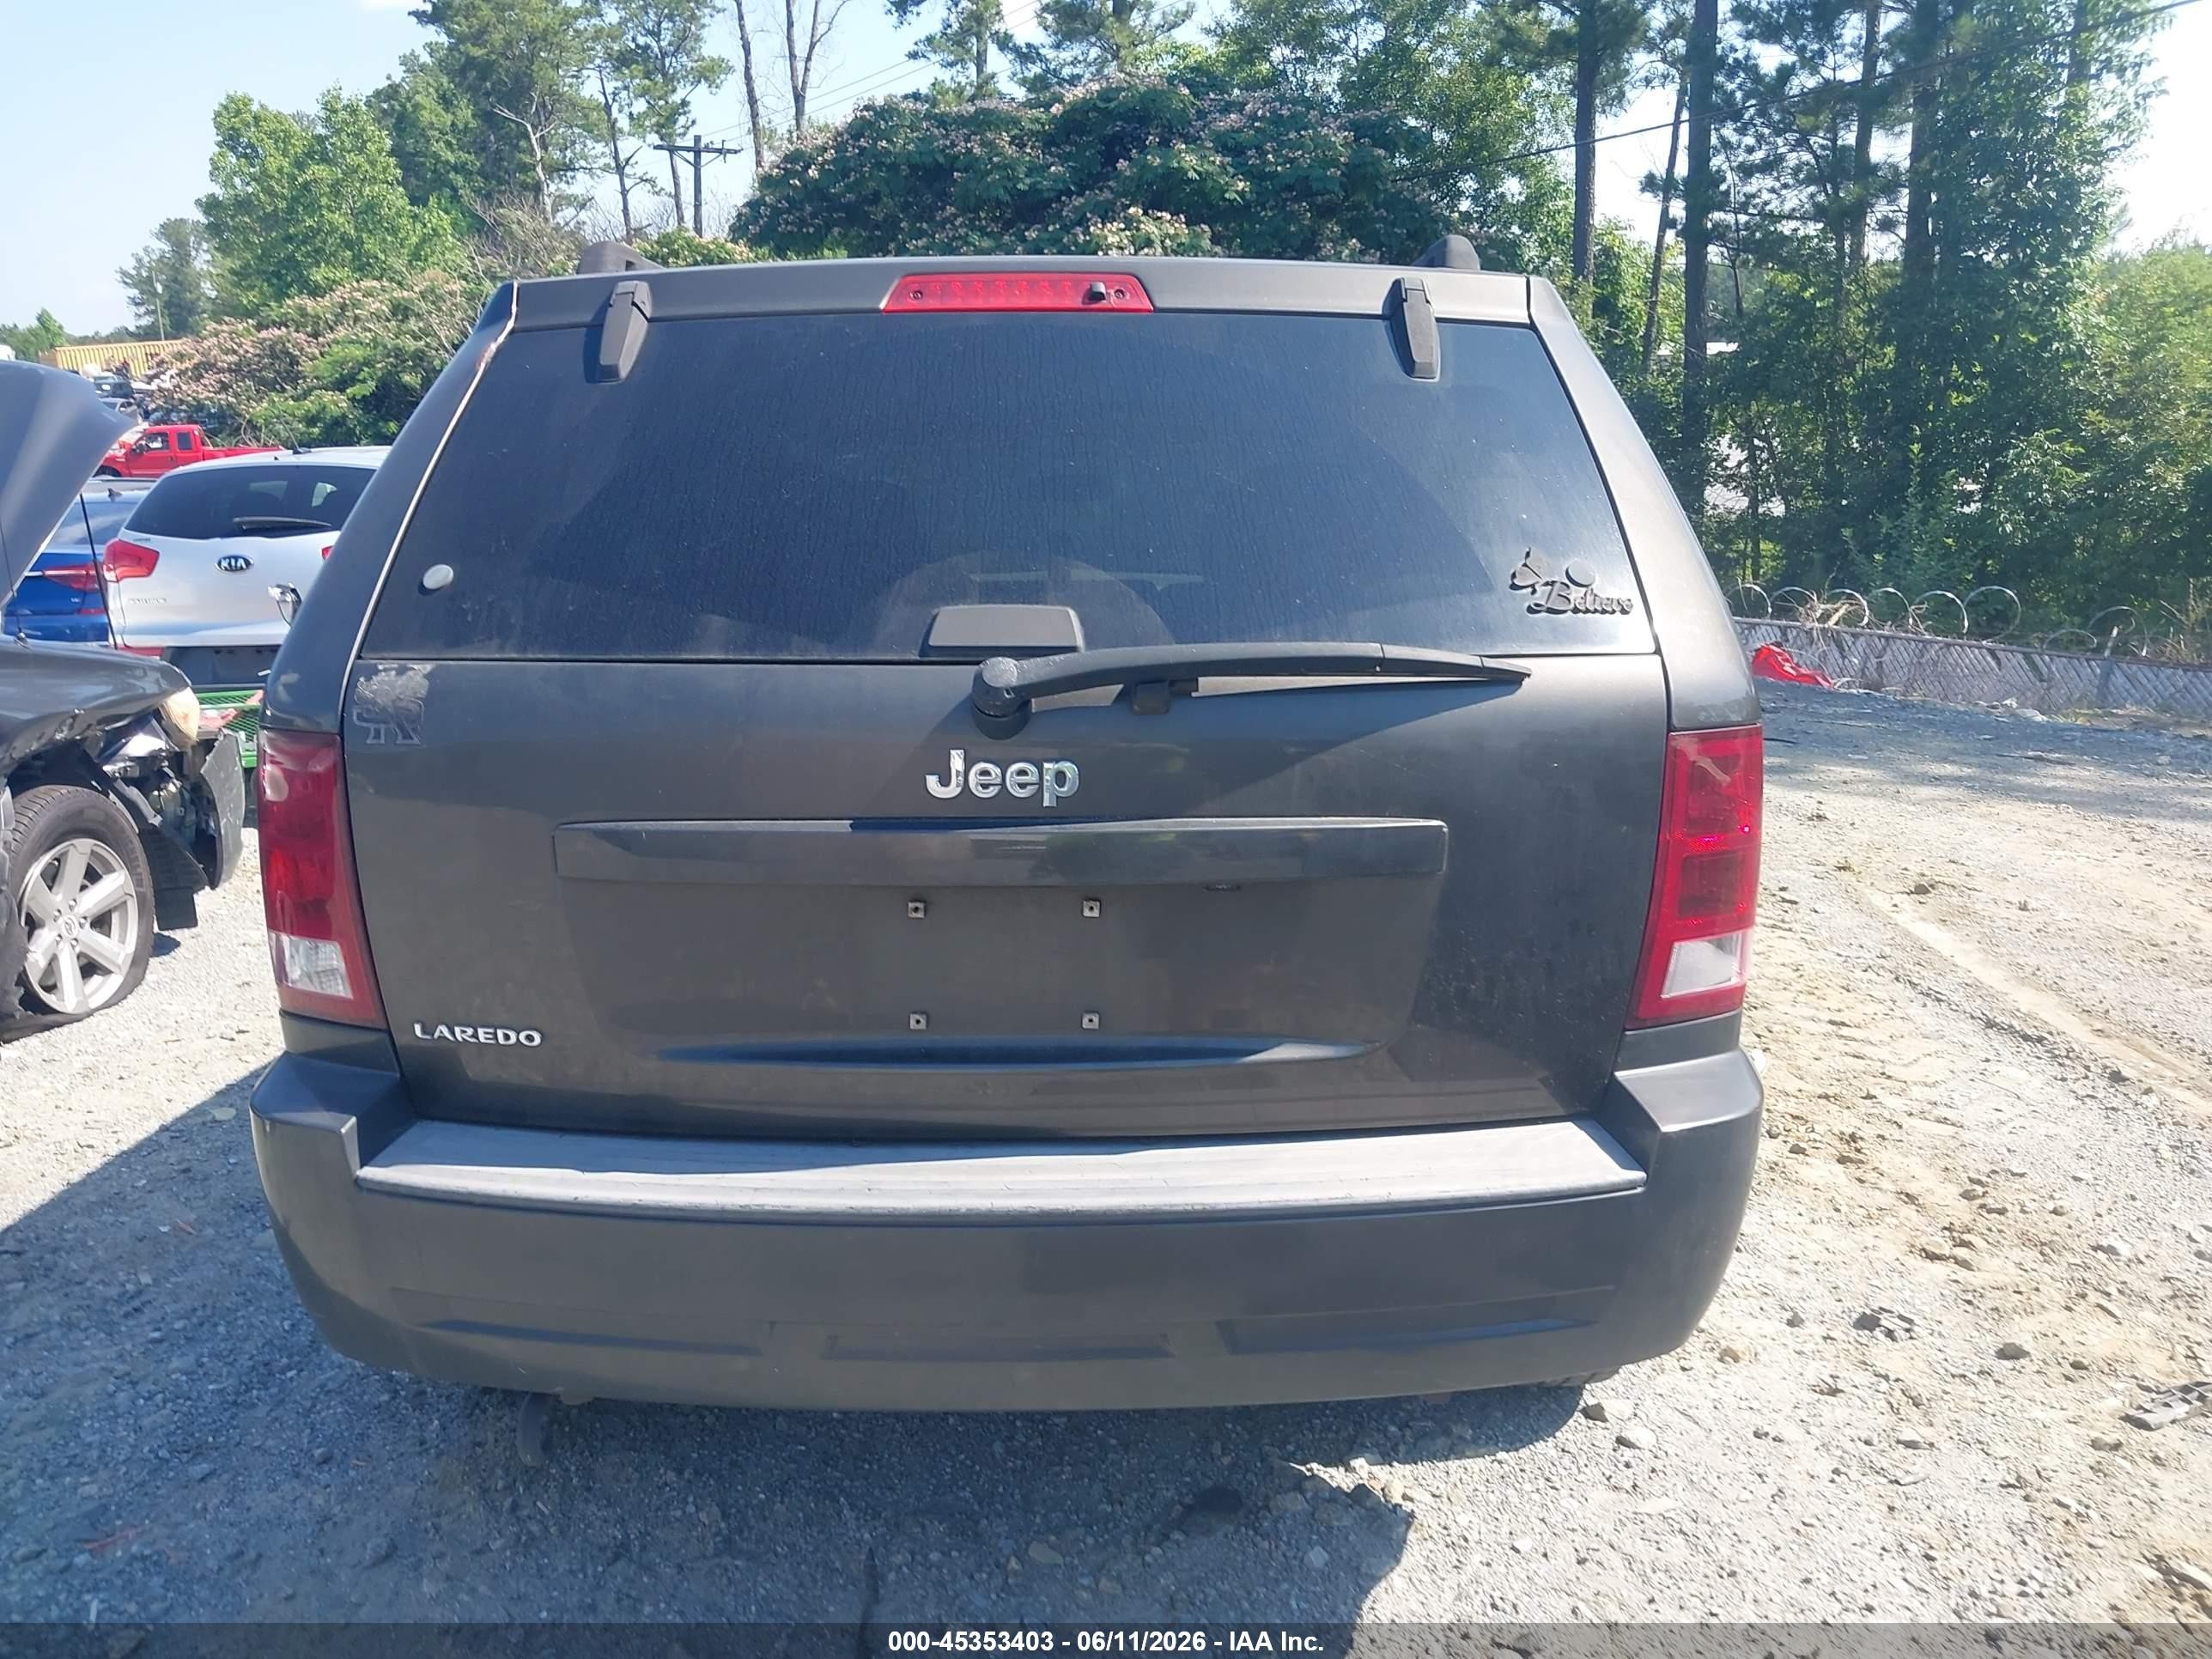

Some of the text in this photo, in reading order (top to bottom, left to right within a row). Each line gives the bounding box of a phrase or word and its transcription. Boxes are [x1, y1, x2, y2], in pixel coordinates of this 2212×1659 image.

[220, 557, 246, 570] KIA
[925, 748, 1080, 808] Jeep
[412, 1021, 543, 1048] LAREDO
